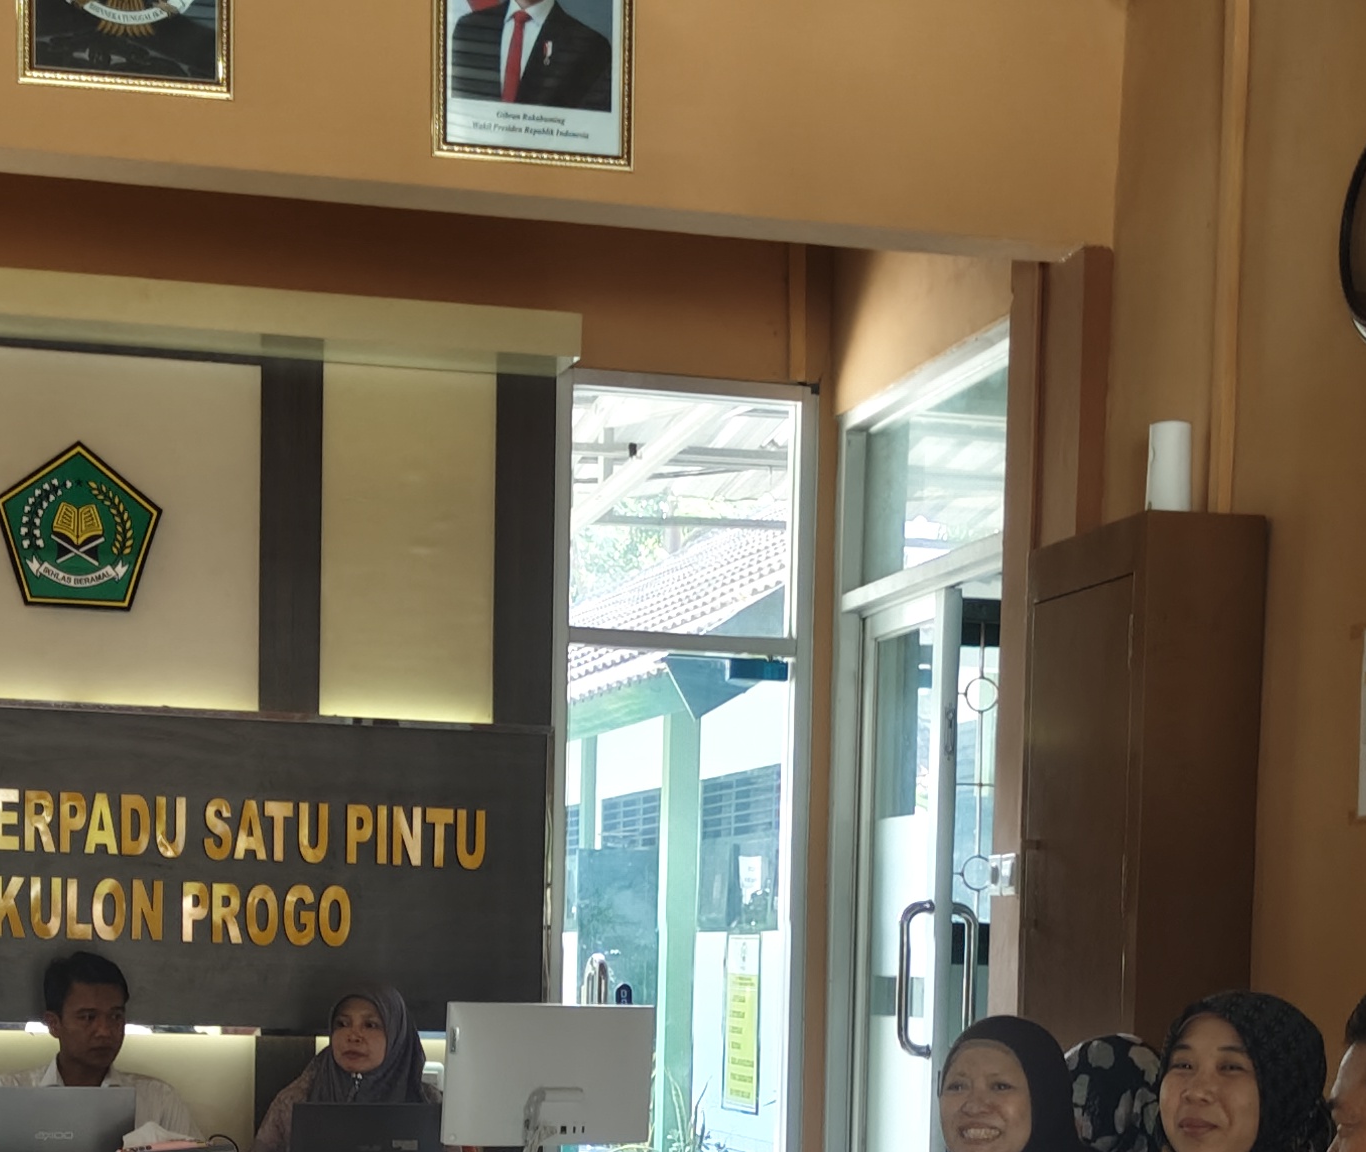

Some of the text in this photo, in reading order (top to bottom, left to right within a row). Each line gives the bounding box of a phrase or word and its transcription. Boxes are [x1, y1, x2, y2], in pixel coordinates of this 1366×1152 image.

[496, 111, 521, 121] Gibran
[493, 123, 523, 133] Presiden
[524, 125, 555, 137] Republik
[555, 128, 590, 139] Indonesia
[42, 566, 113, 587] IKHLAS BERAMAL
[204, 798, 329, 864] SATU
[345, 803, 486, 870] PINTU
[182, 881, 351, 947] PROGO
